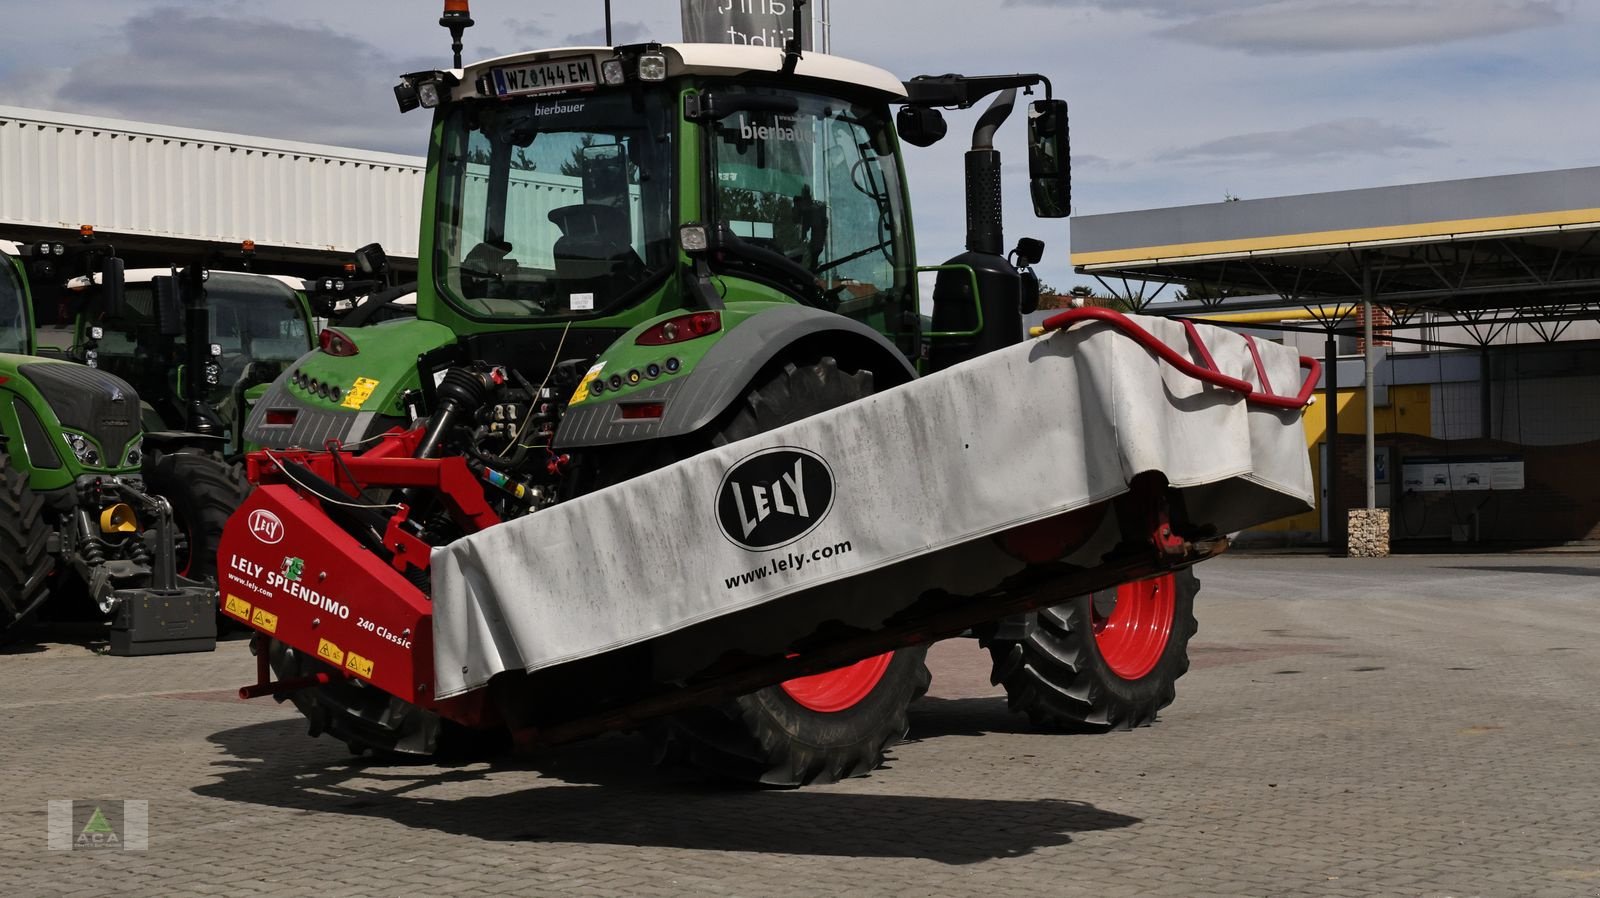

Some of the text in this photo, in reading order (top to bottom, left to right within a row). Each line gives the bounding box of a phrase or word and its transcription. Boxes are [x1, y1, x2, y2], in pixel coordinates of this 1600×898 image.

[505, 61, 590, 90] WZ 144 EM
[534, 101, 585, 116] bierbauer
[731, 457, 809, 540] LELY
[254, 513, 279, 539] LELY
[725, 540, 852, 589] www.lely.com
[228, 572, 273, 598] www.lely.com
[231, 554, 412, 649] LELY SPLENDIMO 240 Classic
